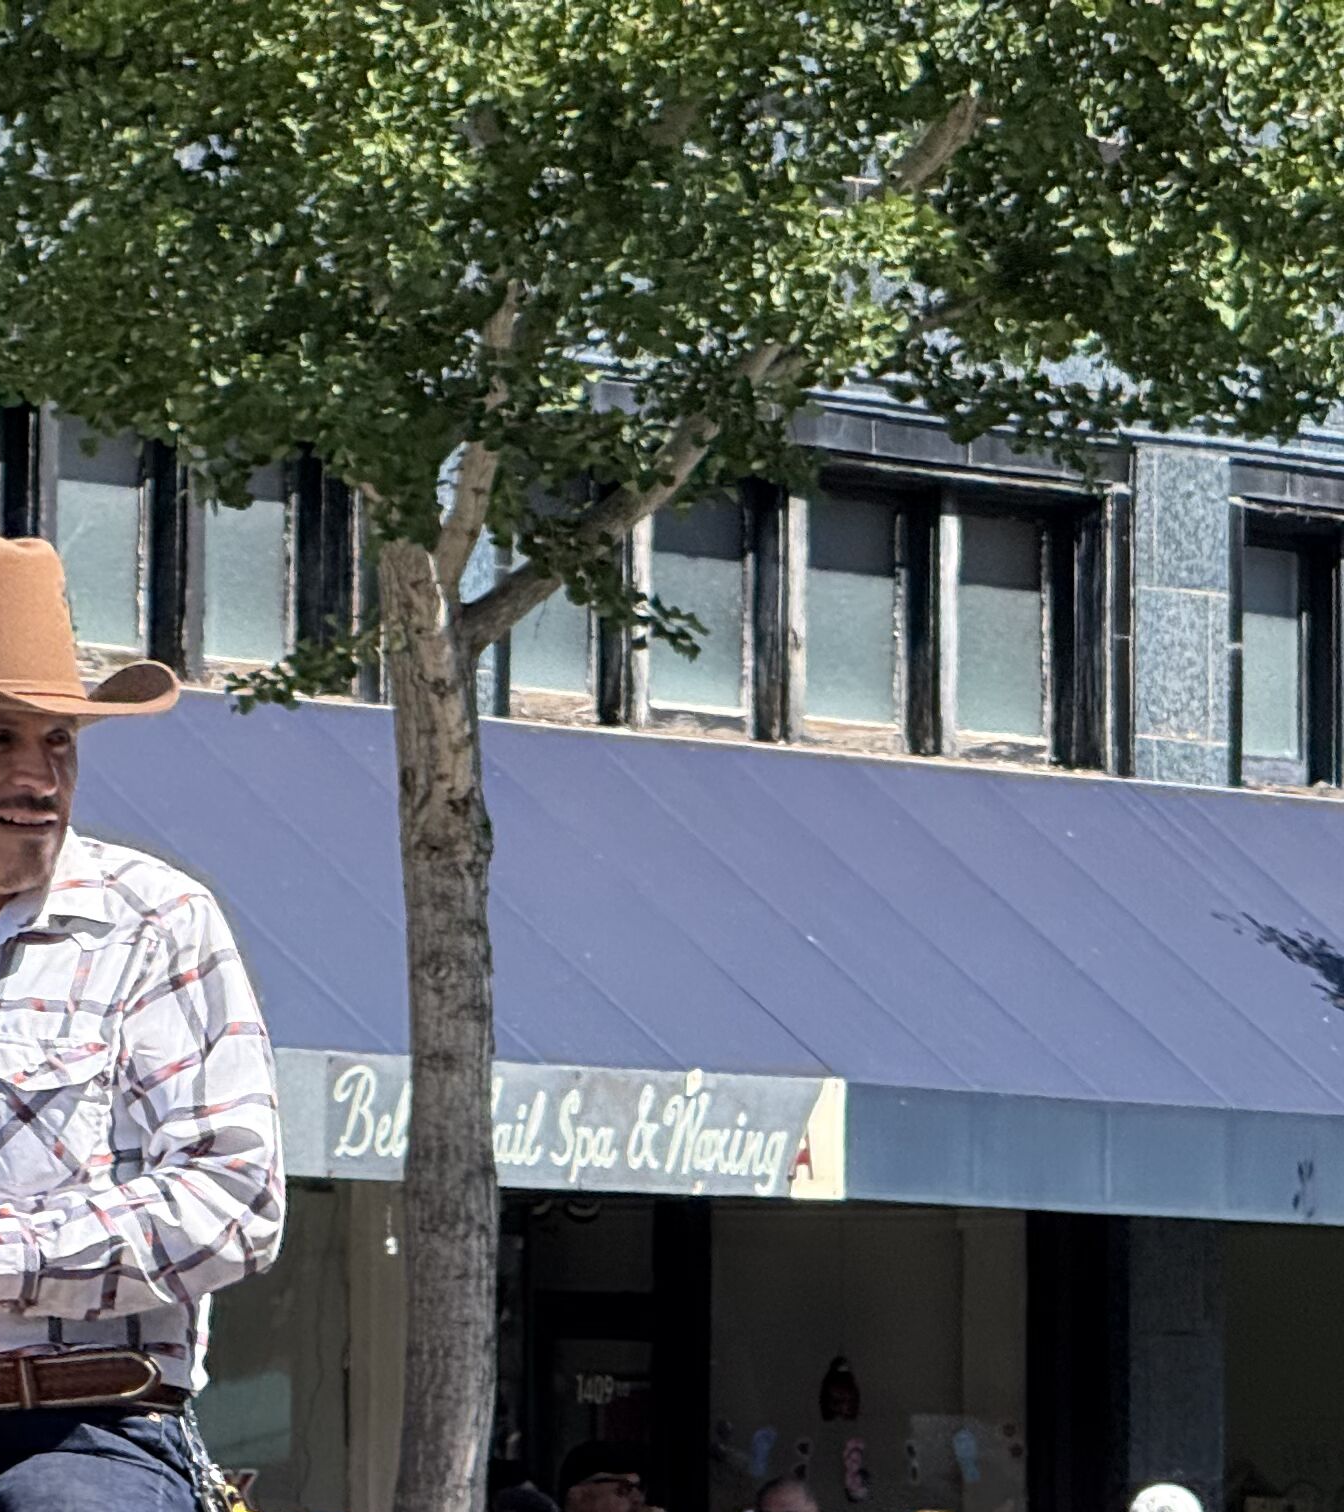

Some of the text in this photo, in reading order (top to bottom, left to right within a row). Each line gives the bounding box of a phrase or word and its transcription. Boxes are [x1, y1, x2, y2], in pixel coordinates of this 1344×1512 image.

[491, 1076, 546, 1166] ail
[550, 1088, 618, 1183] Spa
[626, 1083, 661, 1170] &
[662, 1091, 789, 1196] Waxing
